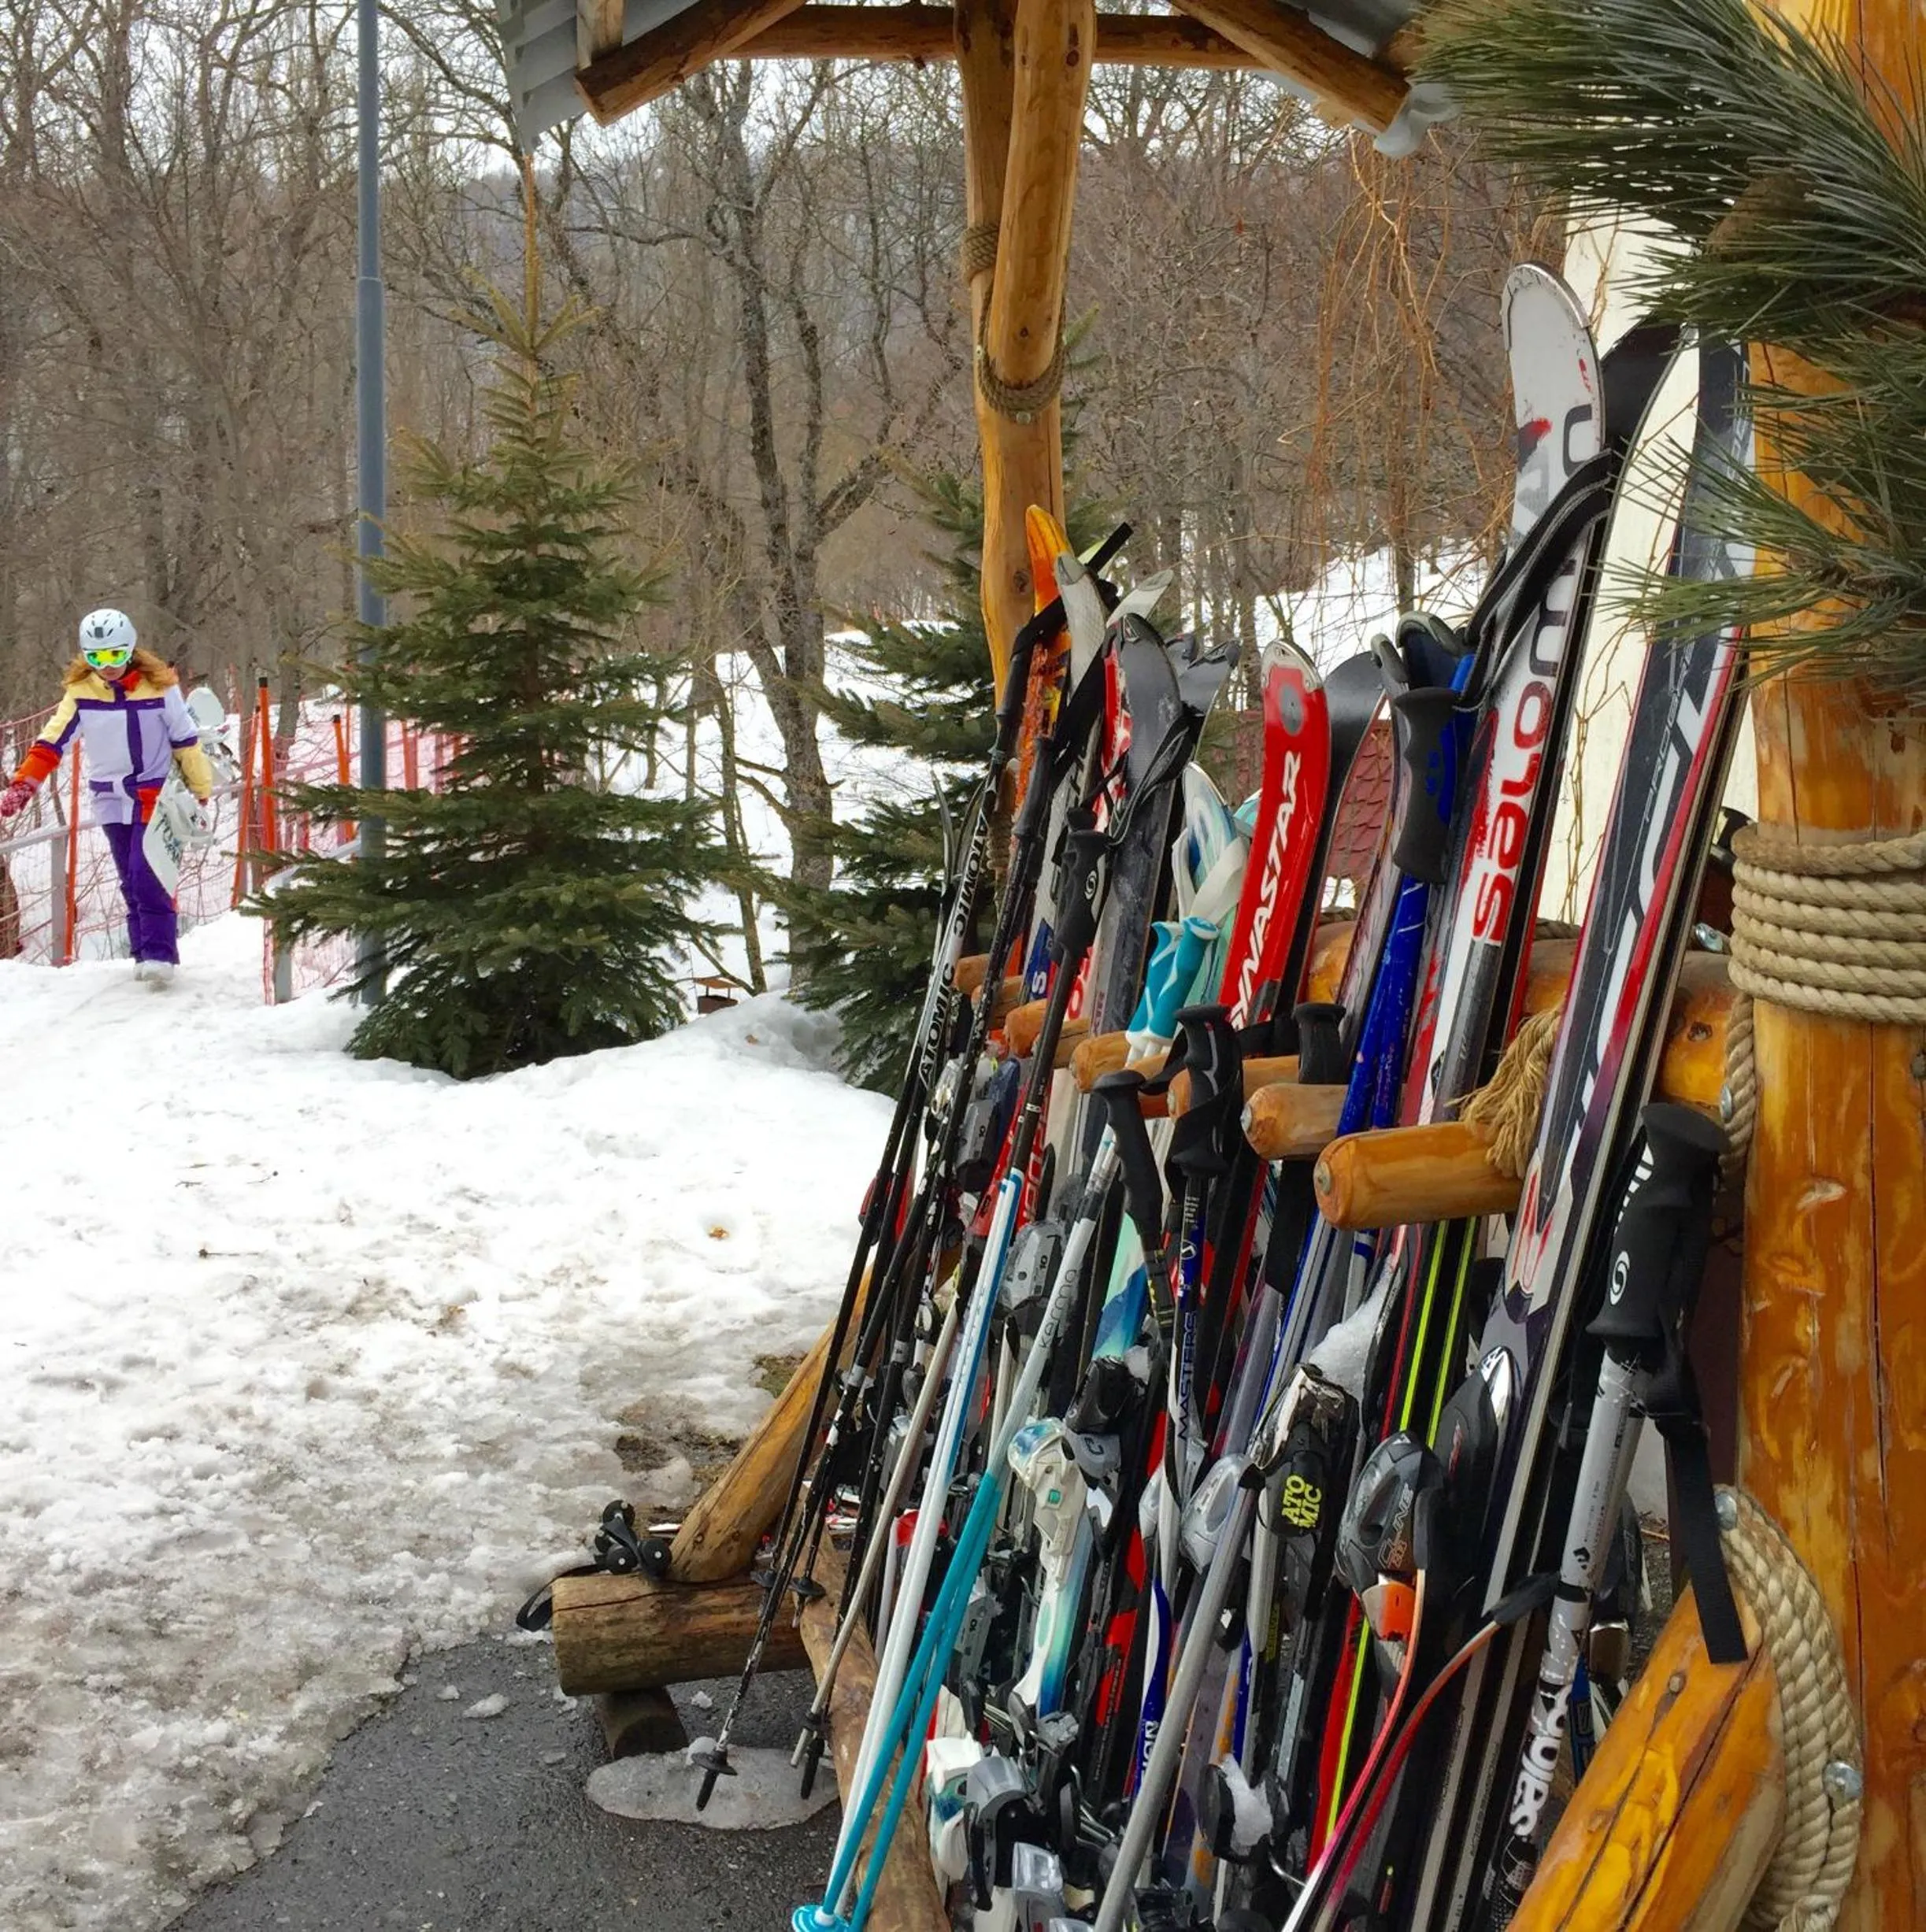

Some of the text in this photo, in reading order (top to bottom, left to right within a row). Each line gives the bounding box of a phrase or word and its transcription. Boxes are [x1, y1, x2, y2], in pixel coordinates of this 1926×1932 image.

[953, 809, 989, 939] ATOMIC
[920, 961, 956, 1091] ATOMIC
[1281, 1474, 1306, 1525] ATO
[1298, 1483, 1322, 1529] MIC
